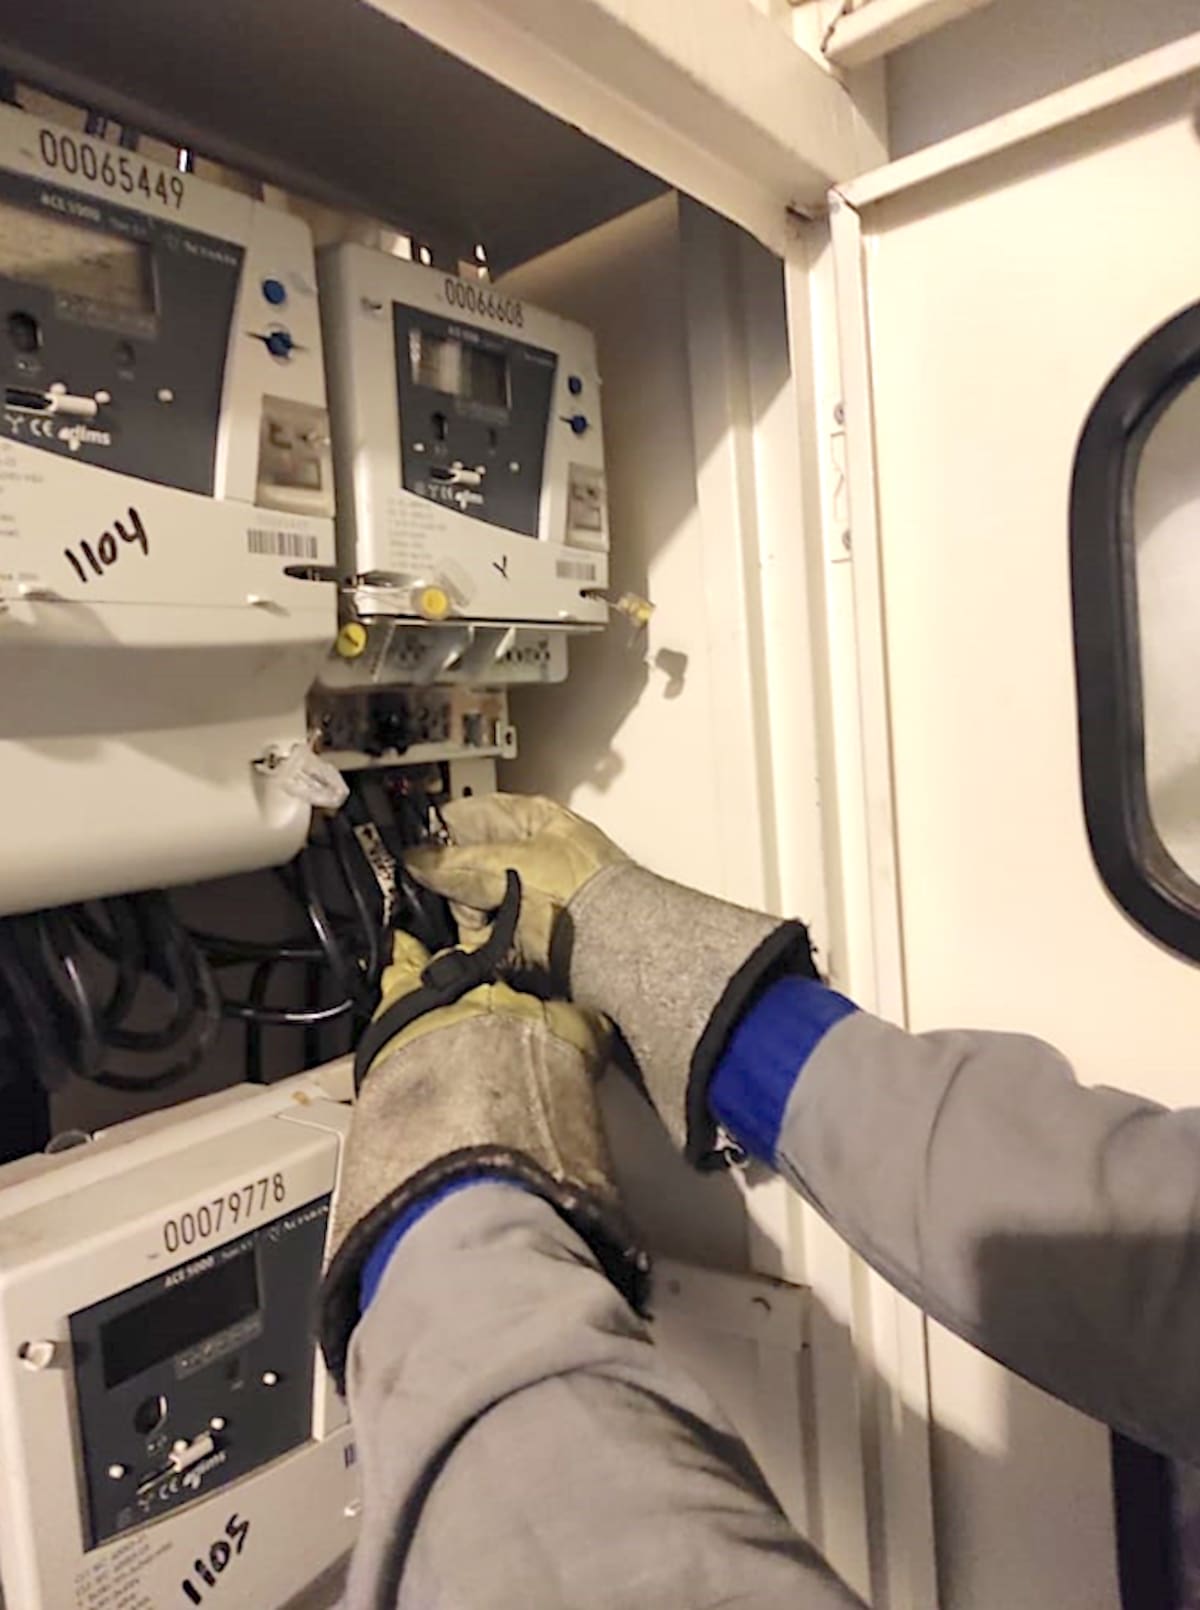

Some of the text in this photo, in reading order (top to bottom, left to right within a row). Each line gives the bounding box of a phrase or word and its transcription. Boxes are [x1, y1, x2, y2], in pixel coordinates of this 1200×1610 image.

[39, 129, 184, 209] 00065449
[64, 506, 149, 583] 1104
[163, 1172, 286, 1253] 00079778
[182, 1514, 249, 1605] 1105
